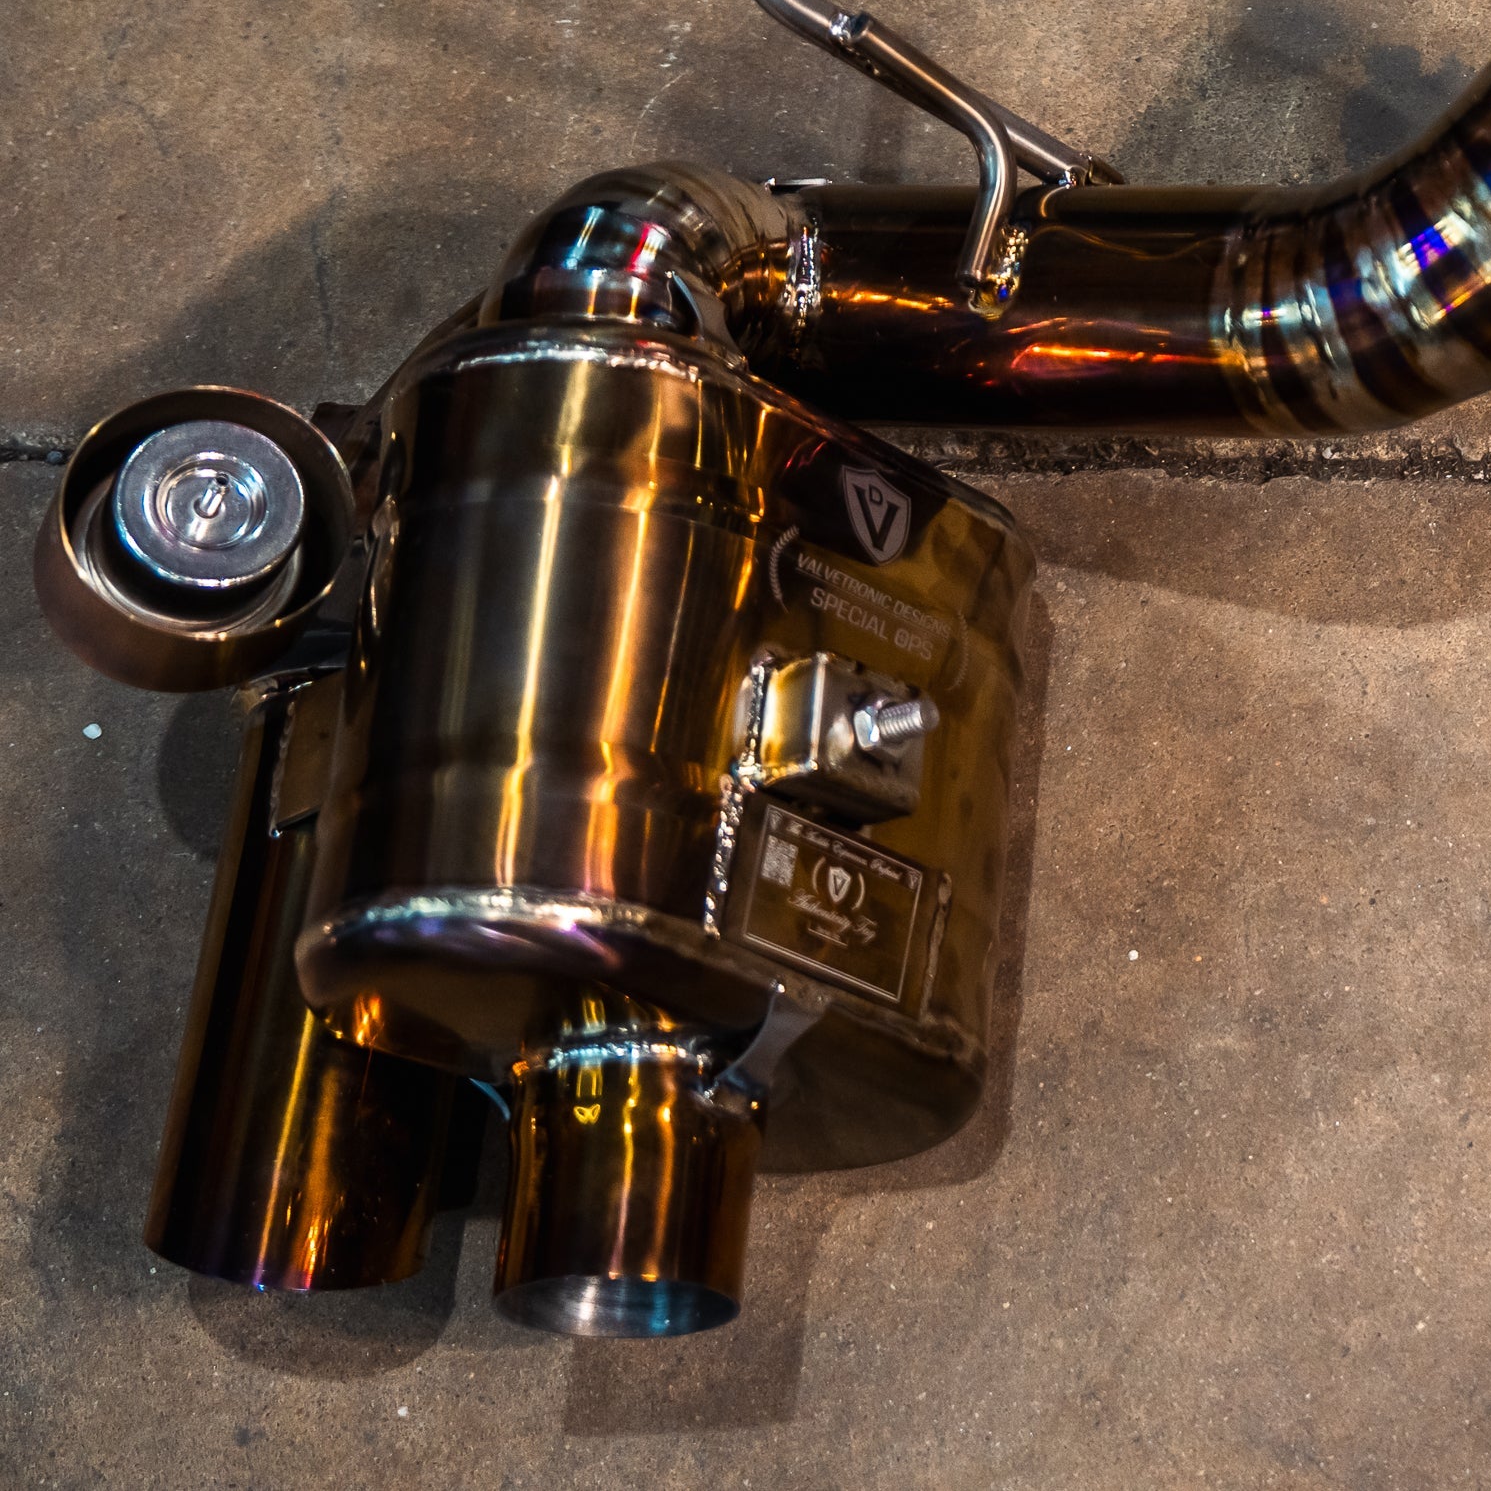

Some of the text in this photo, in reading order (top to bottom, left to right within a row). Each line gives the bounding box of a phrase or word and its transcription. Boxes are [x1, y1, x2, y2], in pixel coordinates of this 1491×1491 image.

[796, 552, 952, 641] VALVETRONIC DESIGNS
[810, 586, 934, 661] SPECIAL OPS
